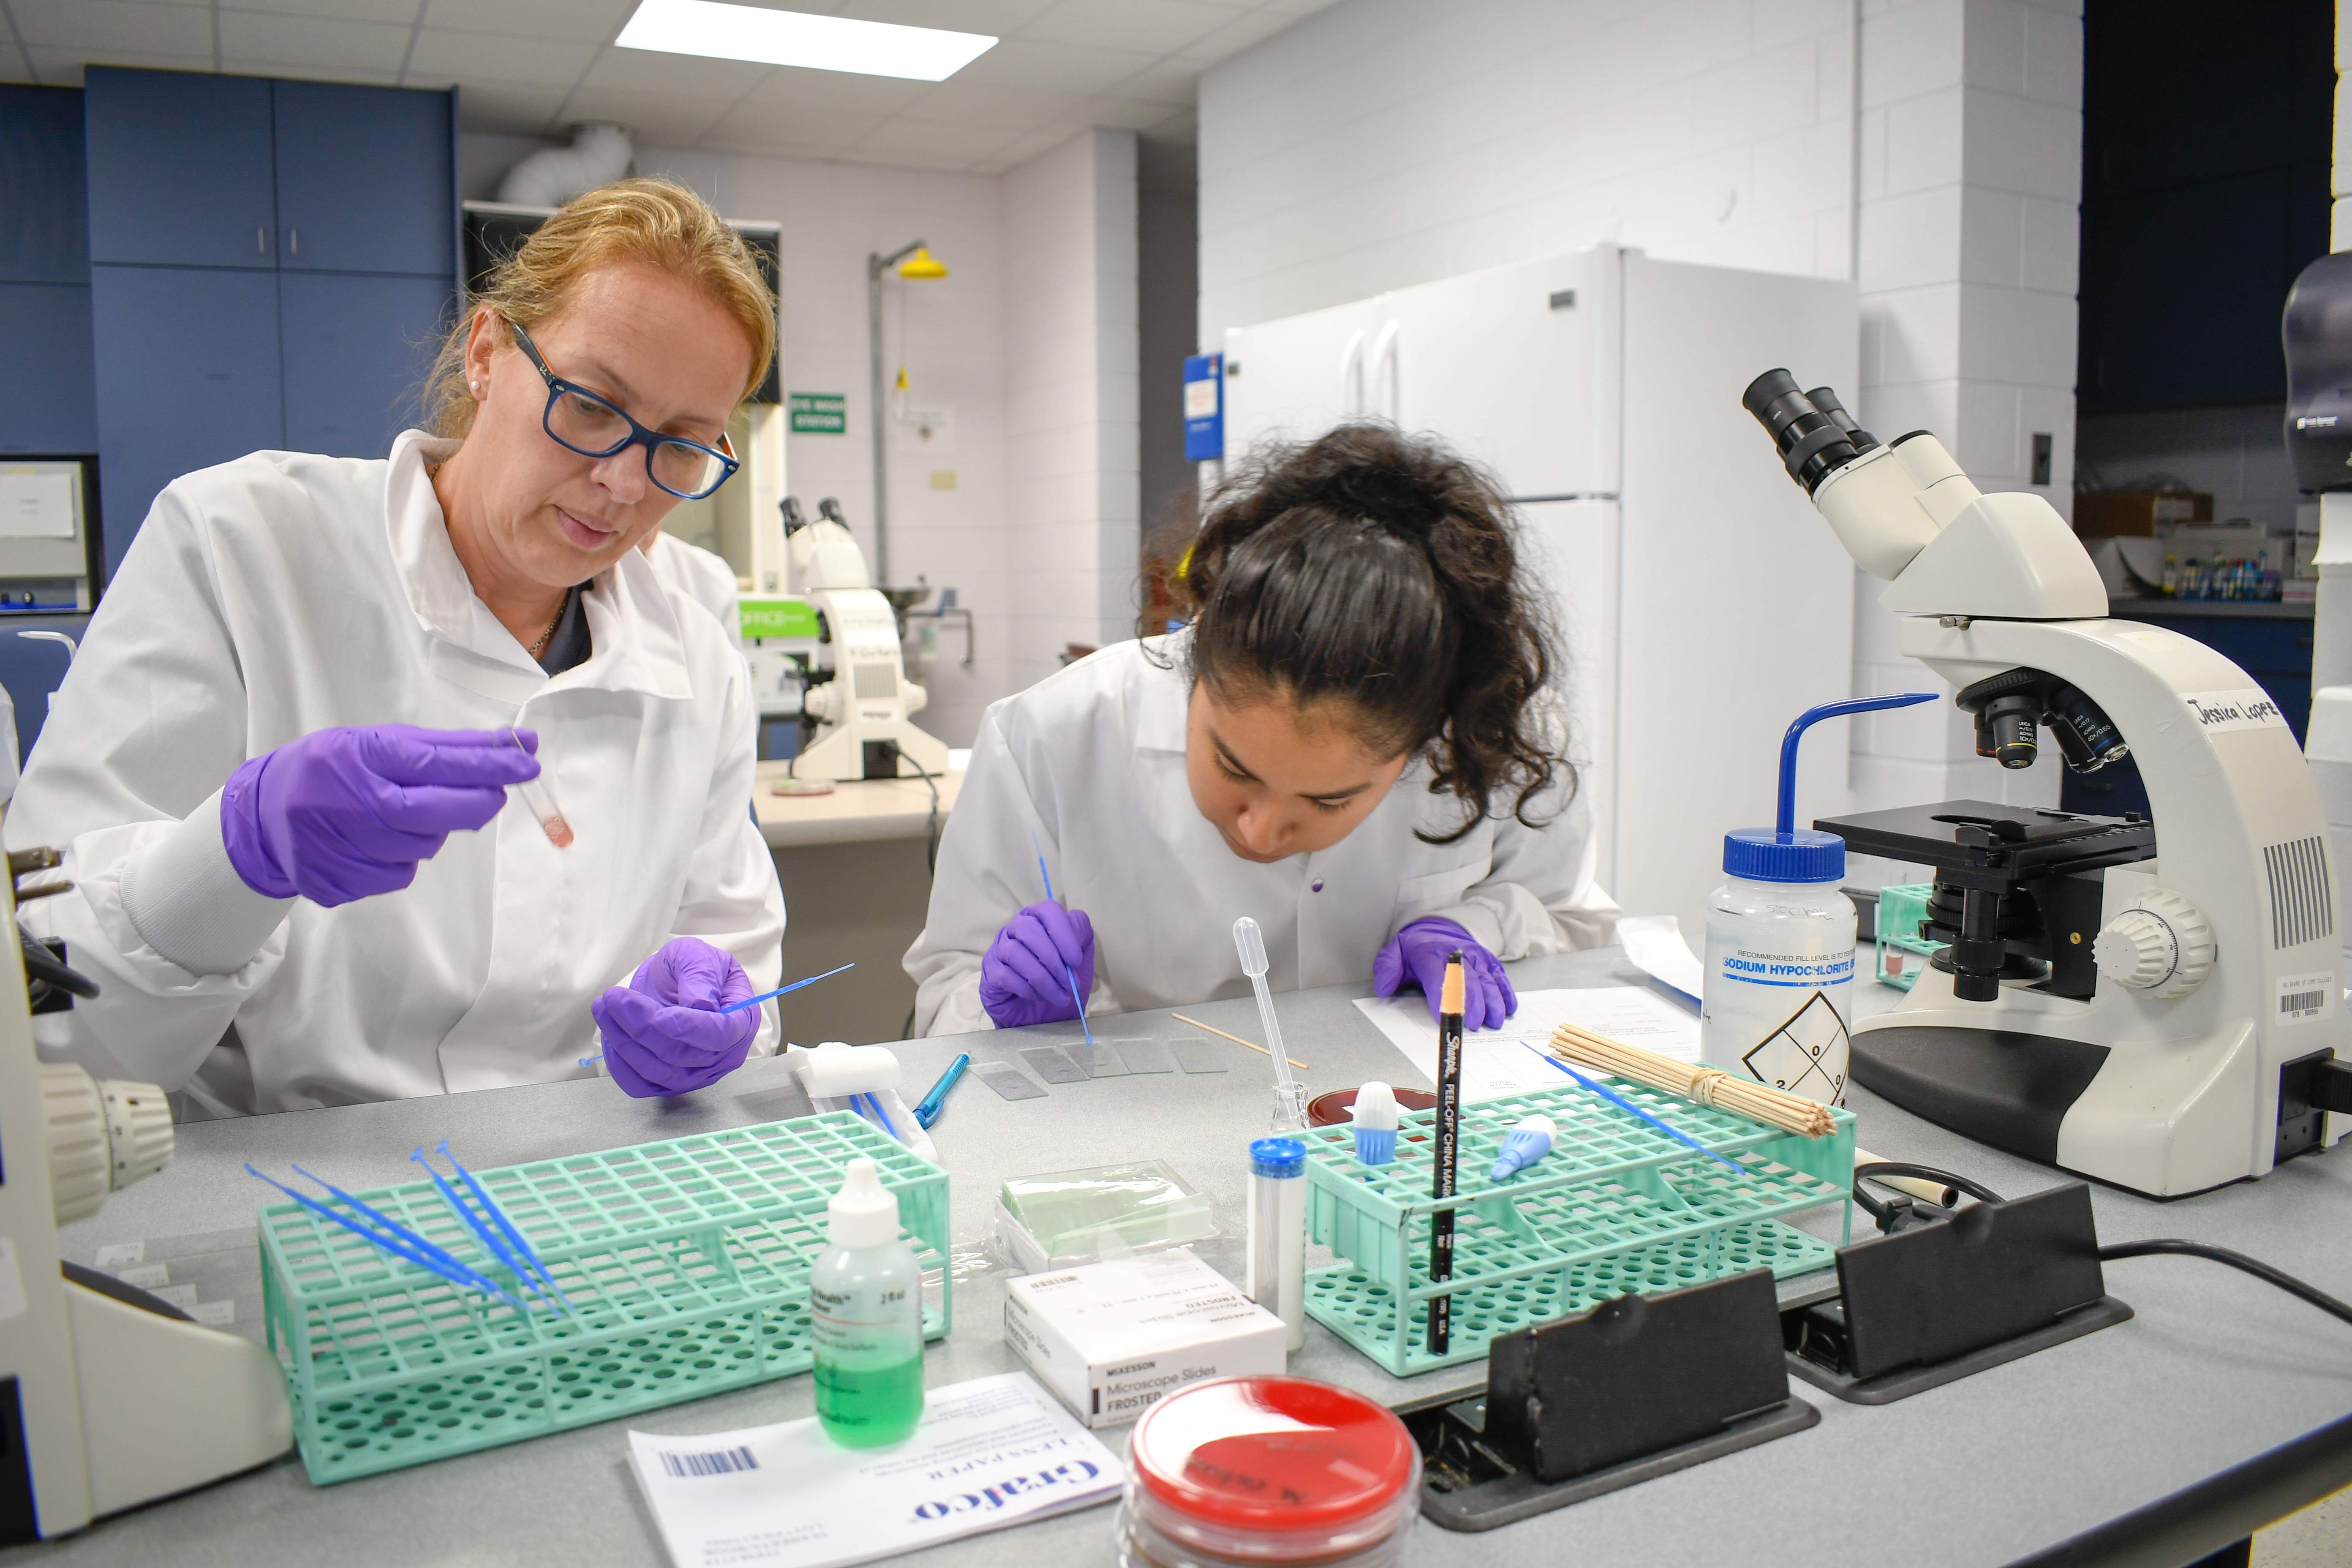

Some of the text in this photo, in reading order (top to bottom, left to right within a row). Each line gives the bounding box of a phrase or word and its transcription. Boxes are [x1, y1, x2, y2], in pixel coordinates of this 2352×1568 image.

[2187, 699, 2279, 725] Jessica Lopez
[1723, 956, 1766, 973] SODIUM
[1770, 961, 1849, 976] HYPOCHLORITE
[1738, 950, 1794, 961] RECOMMENDED
[1443, 1032, 1460, 1076] Sharpie
[1812, 1045, 1820, 1056] 0
[1836, 1074, 1840, 1085] 0
[1442, 1133, 1453, 1167] CHINA
[1440, 1168, 1452, 1198] MARK
[1185, 1295, 1237, 1308] FROSTED
[1107, 1365, 1217, 1396] Microscope Slides
[1107, 1391, 1162, 1412] FROSTED
[928, 1437, 1068, 1480] LENS PAPER
[915, 1459, 1099, 1519] Grafco
